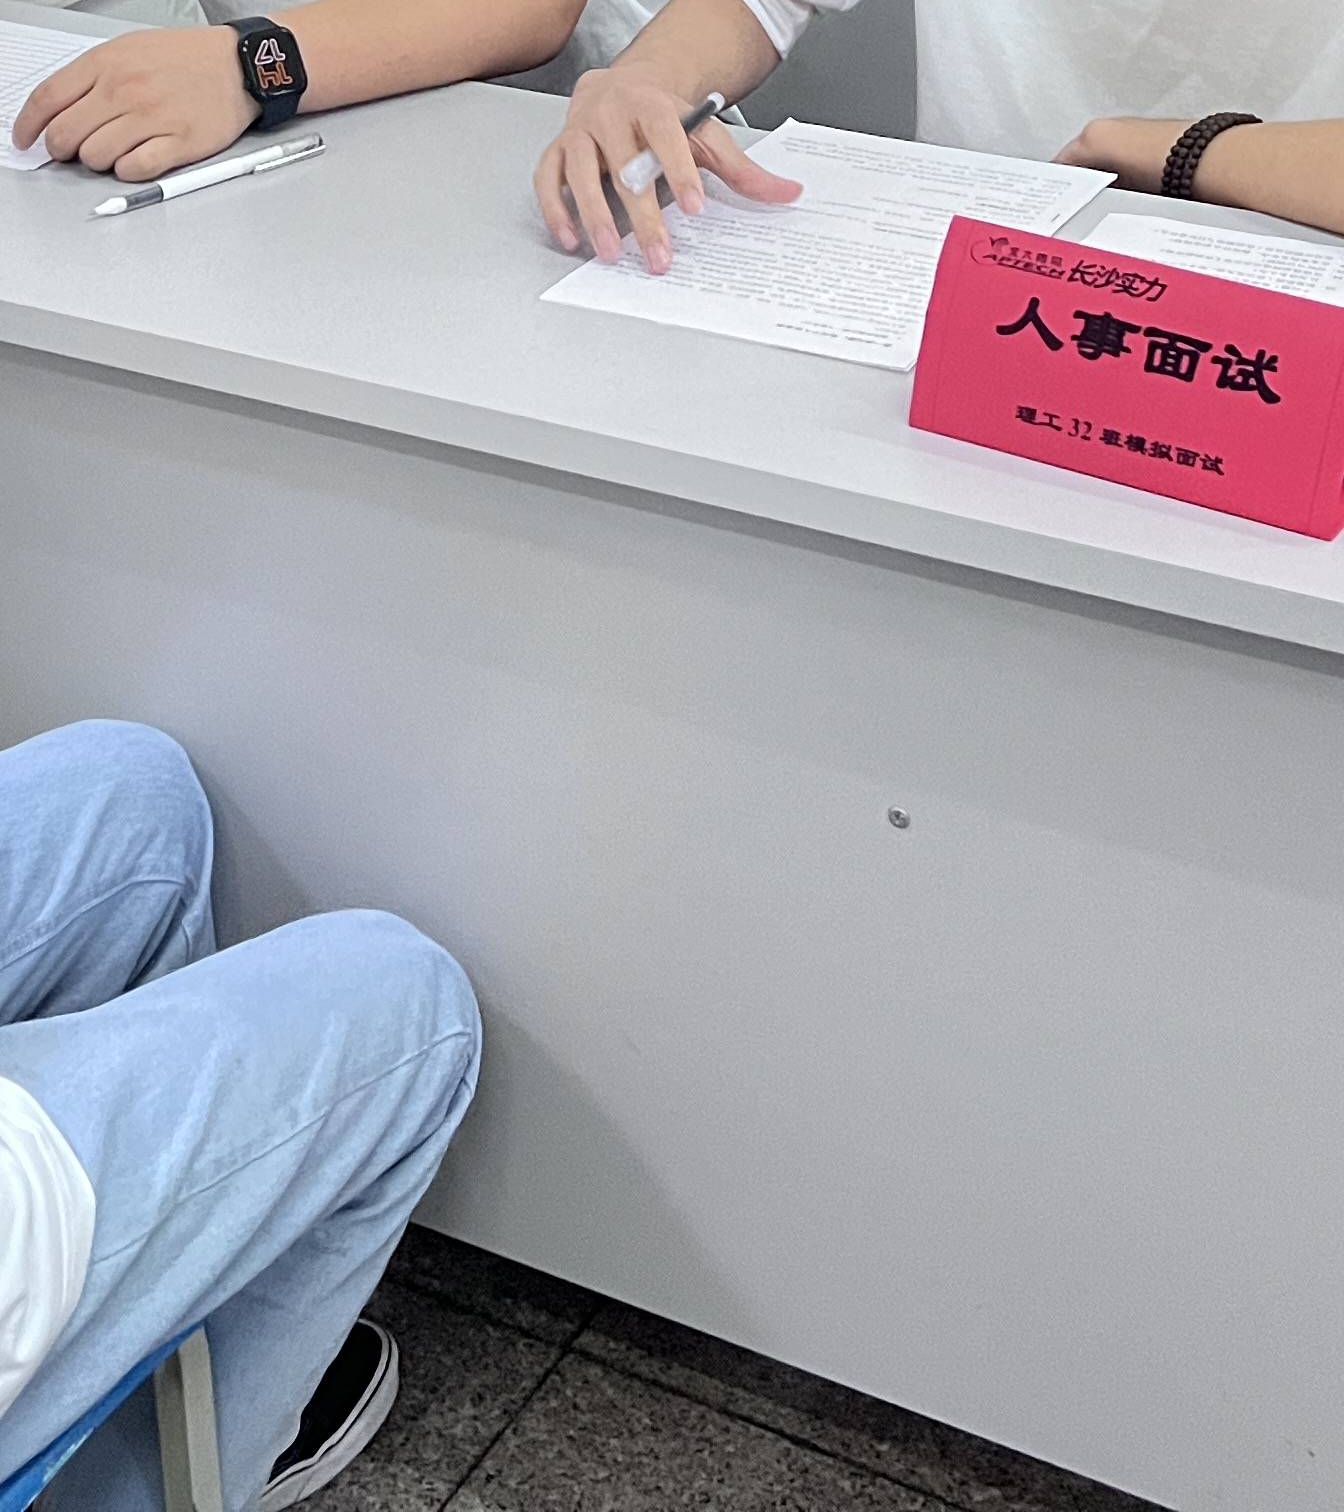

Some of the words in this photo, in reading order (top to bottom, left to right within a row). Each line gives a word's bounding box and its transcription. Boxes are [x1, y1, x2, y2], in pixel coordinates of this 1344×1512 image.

[983, 253, 1066, 278] APTECH
[1067, 260, 1168, 302] 长沙实力
[996, 297, 1282, 405] 人事面试
